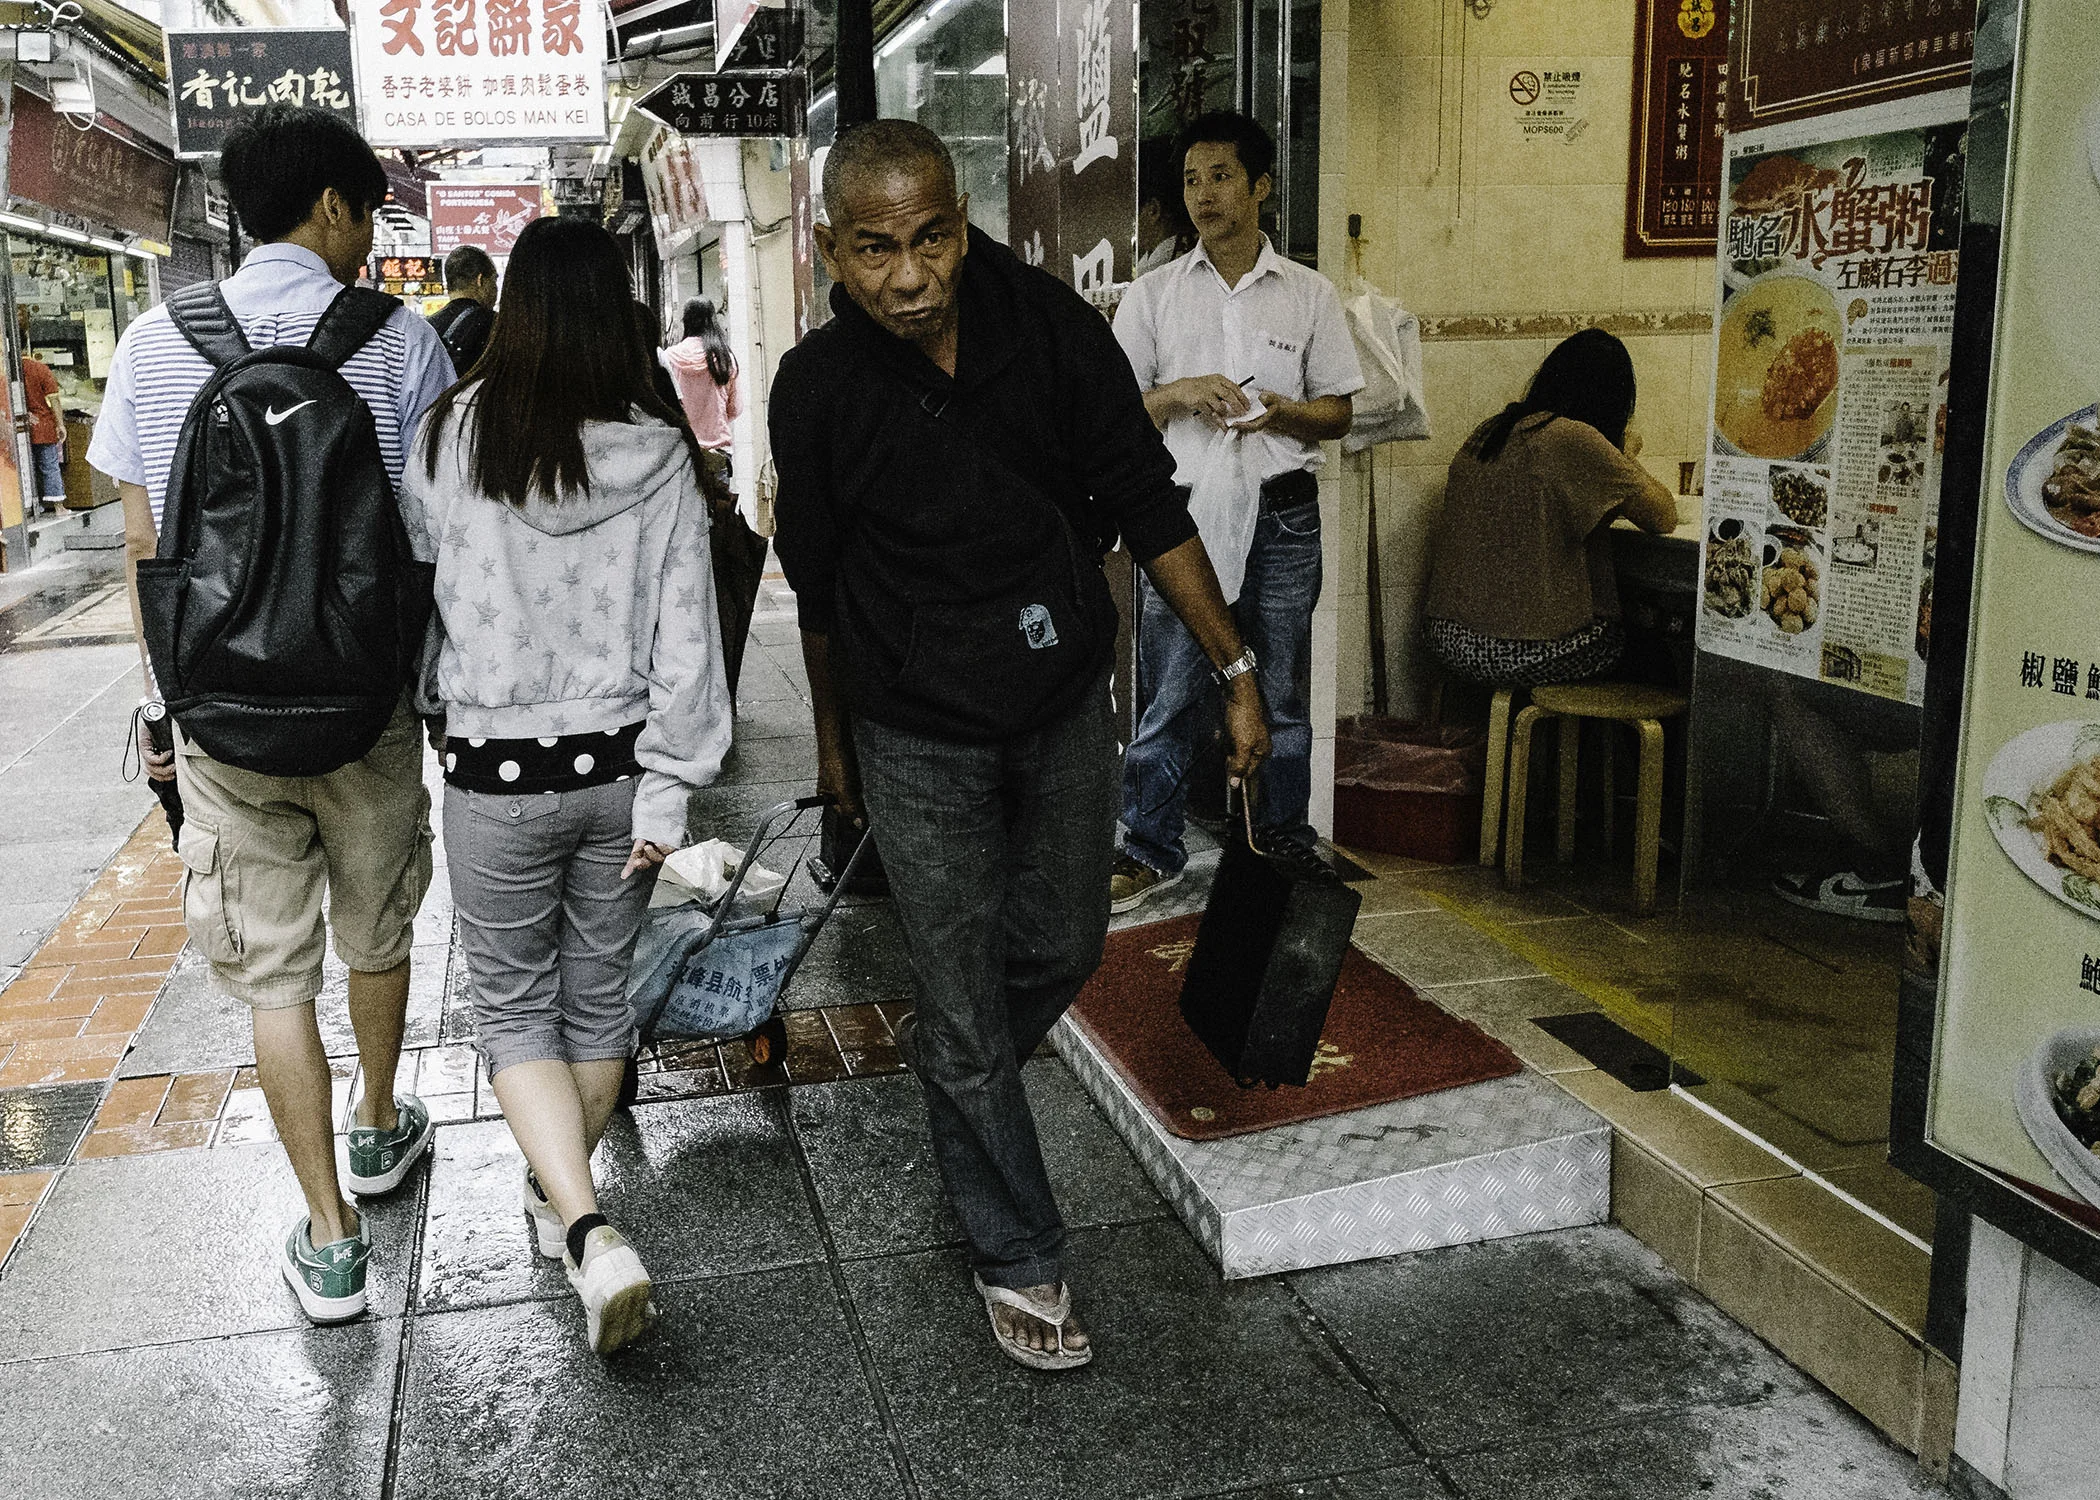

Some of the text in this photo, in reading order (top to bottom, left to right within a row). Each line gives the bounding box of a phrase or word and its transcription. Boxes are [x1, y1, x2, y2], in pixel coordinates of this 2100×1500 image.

[379, 0, 584, 57] 文記餅家
[180, 66, 351, 110] 香記肉乾
[671, 81, 779, 110] 誠昌分店
[384, 109, 590, 127] CASA DE BOLOS MAN KEI
[1836, 250, 1959, 290] 左麟右李過
